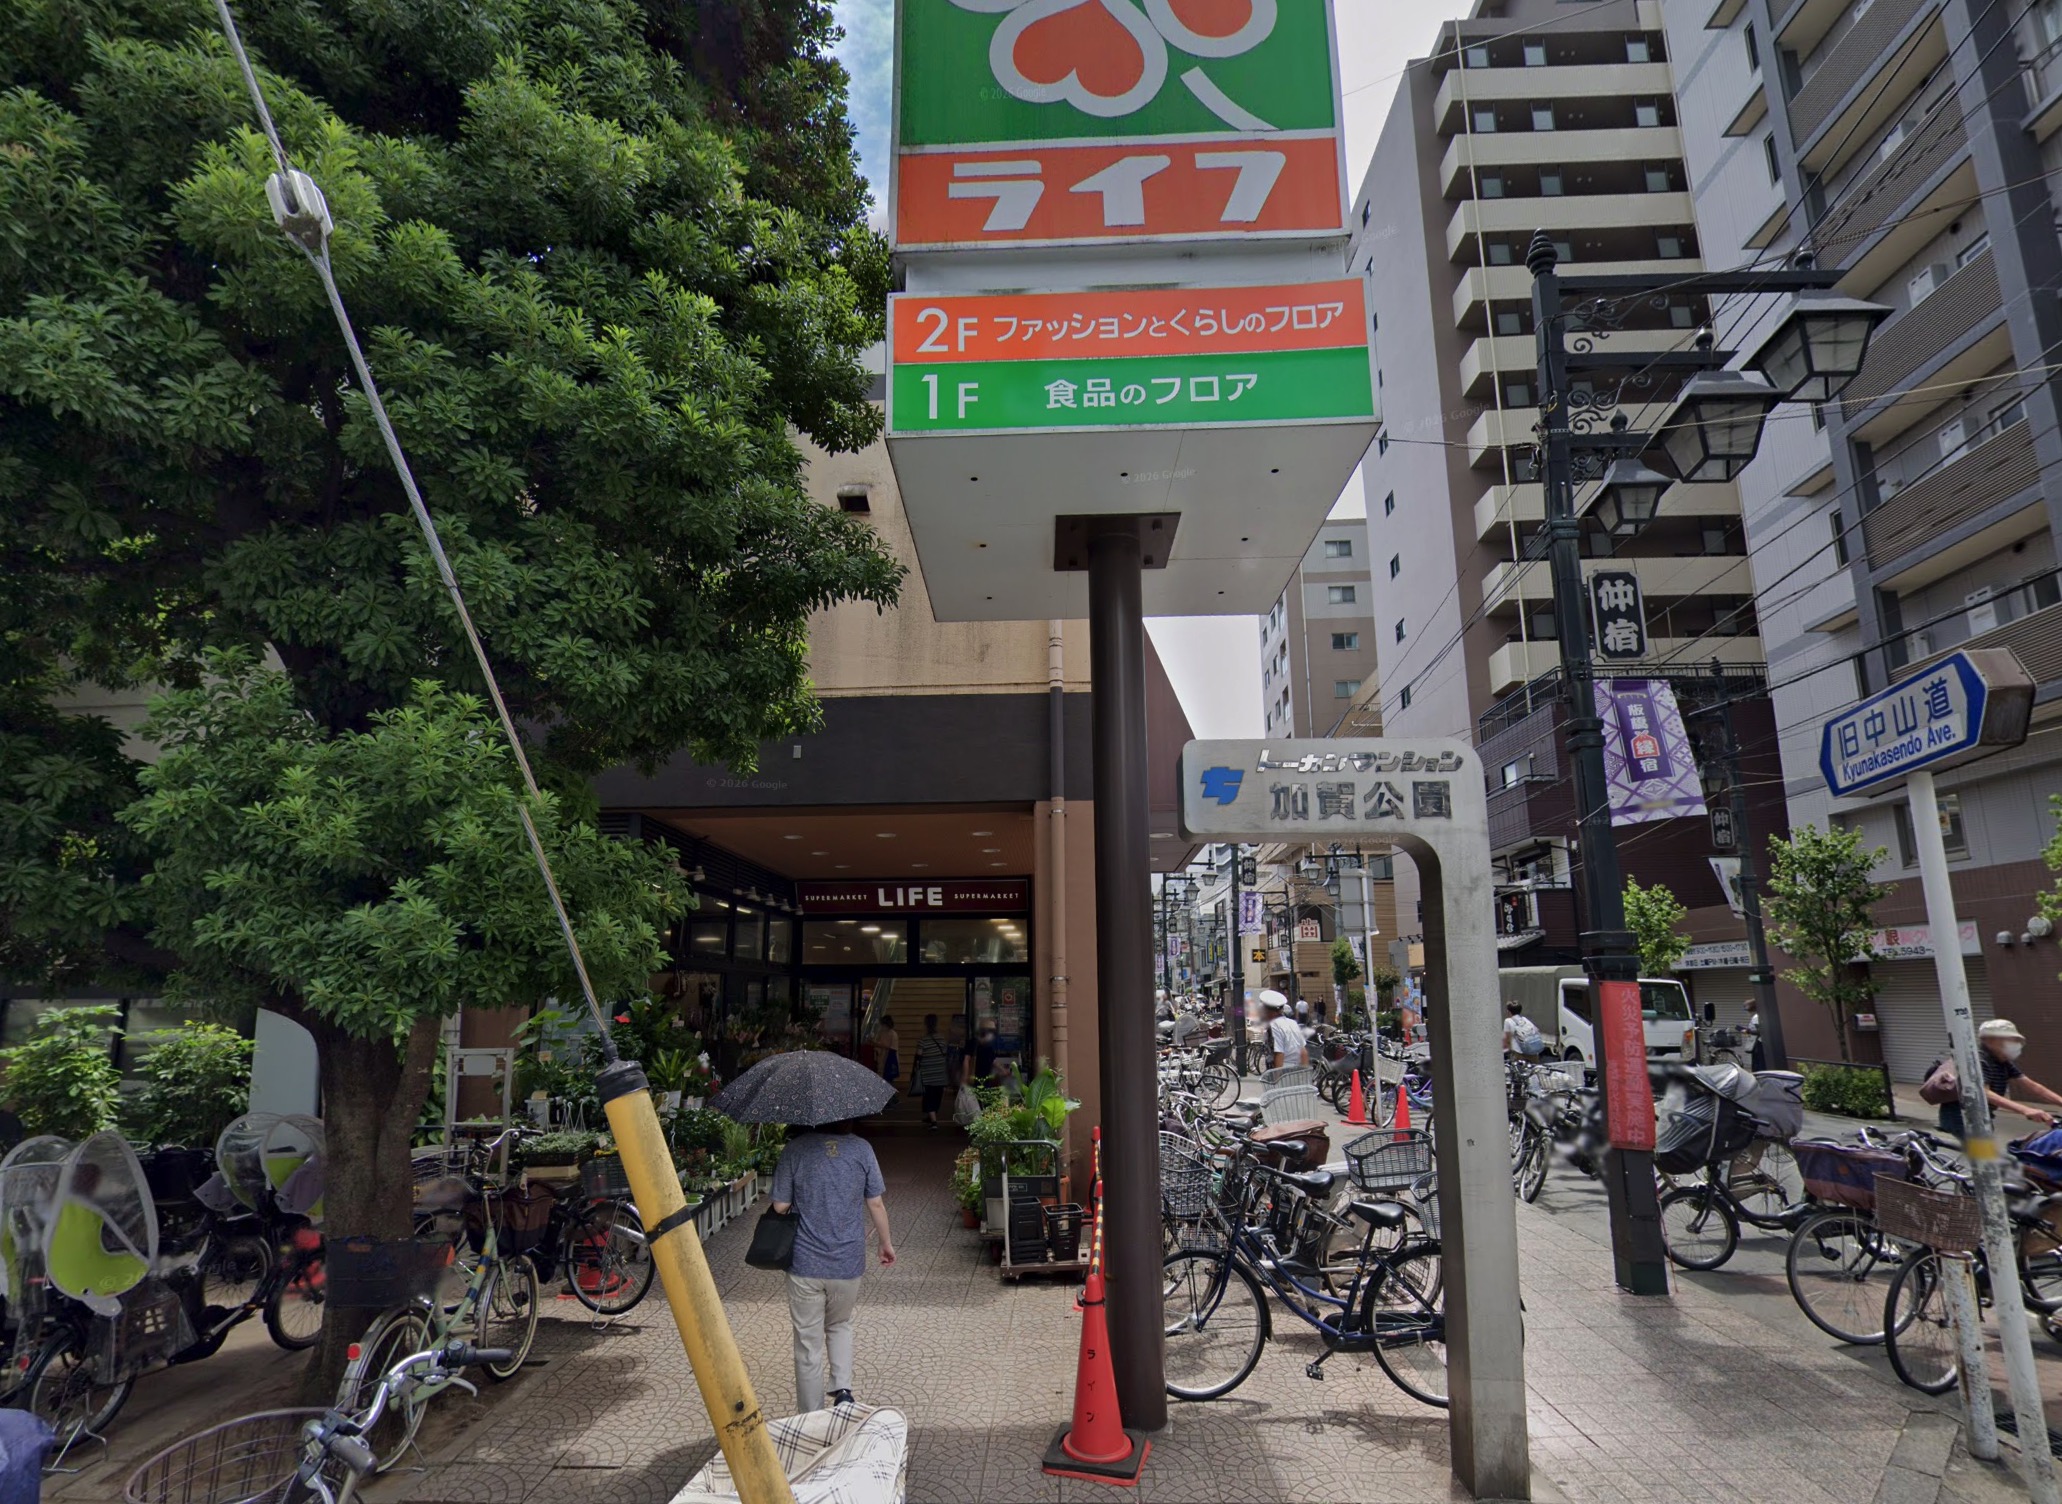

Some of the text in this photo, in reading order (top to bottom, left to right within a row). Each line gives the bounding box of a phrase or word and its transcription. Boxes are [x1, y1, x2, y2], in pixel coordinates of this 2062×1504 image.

[948, 150, 1287, 232] ライフ
[916, 301, 1344, 353] 2F ファッションとくらしのフロア
[921, 373, 1259, 420] 1F 食品のフロア
[1597, 578, 1640, 652] 仲宿
[1837, 676, 1954, 762] 旧中山道
[1255, 748, 1464, 773] トーカンマンション
[1842, 723, 1956, 782] Kyunakasendo Ave.
[1269, 780, 1452, 821] 加賀公園
[804, 887, 1019, 907] SUPERMARKET LIFE SUPERMARKET
